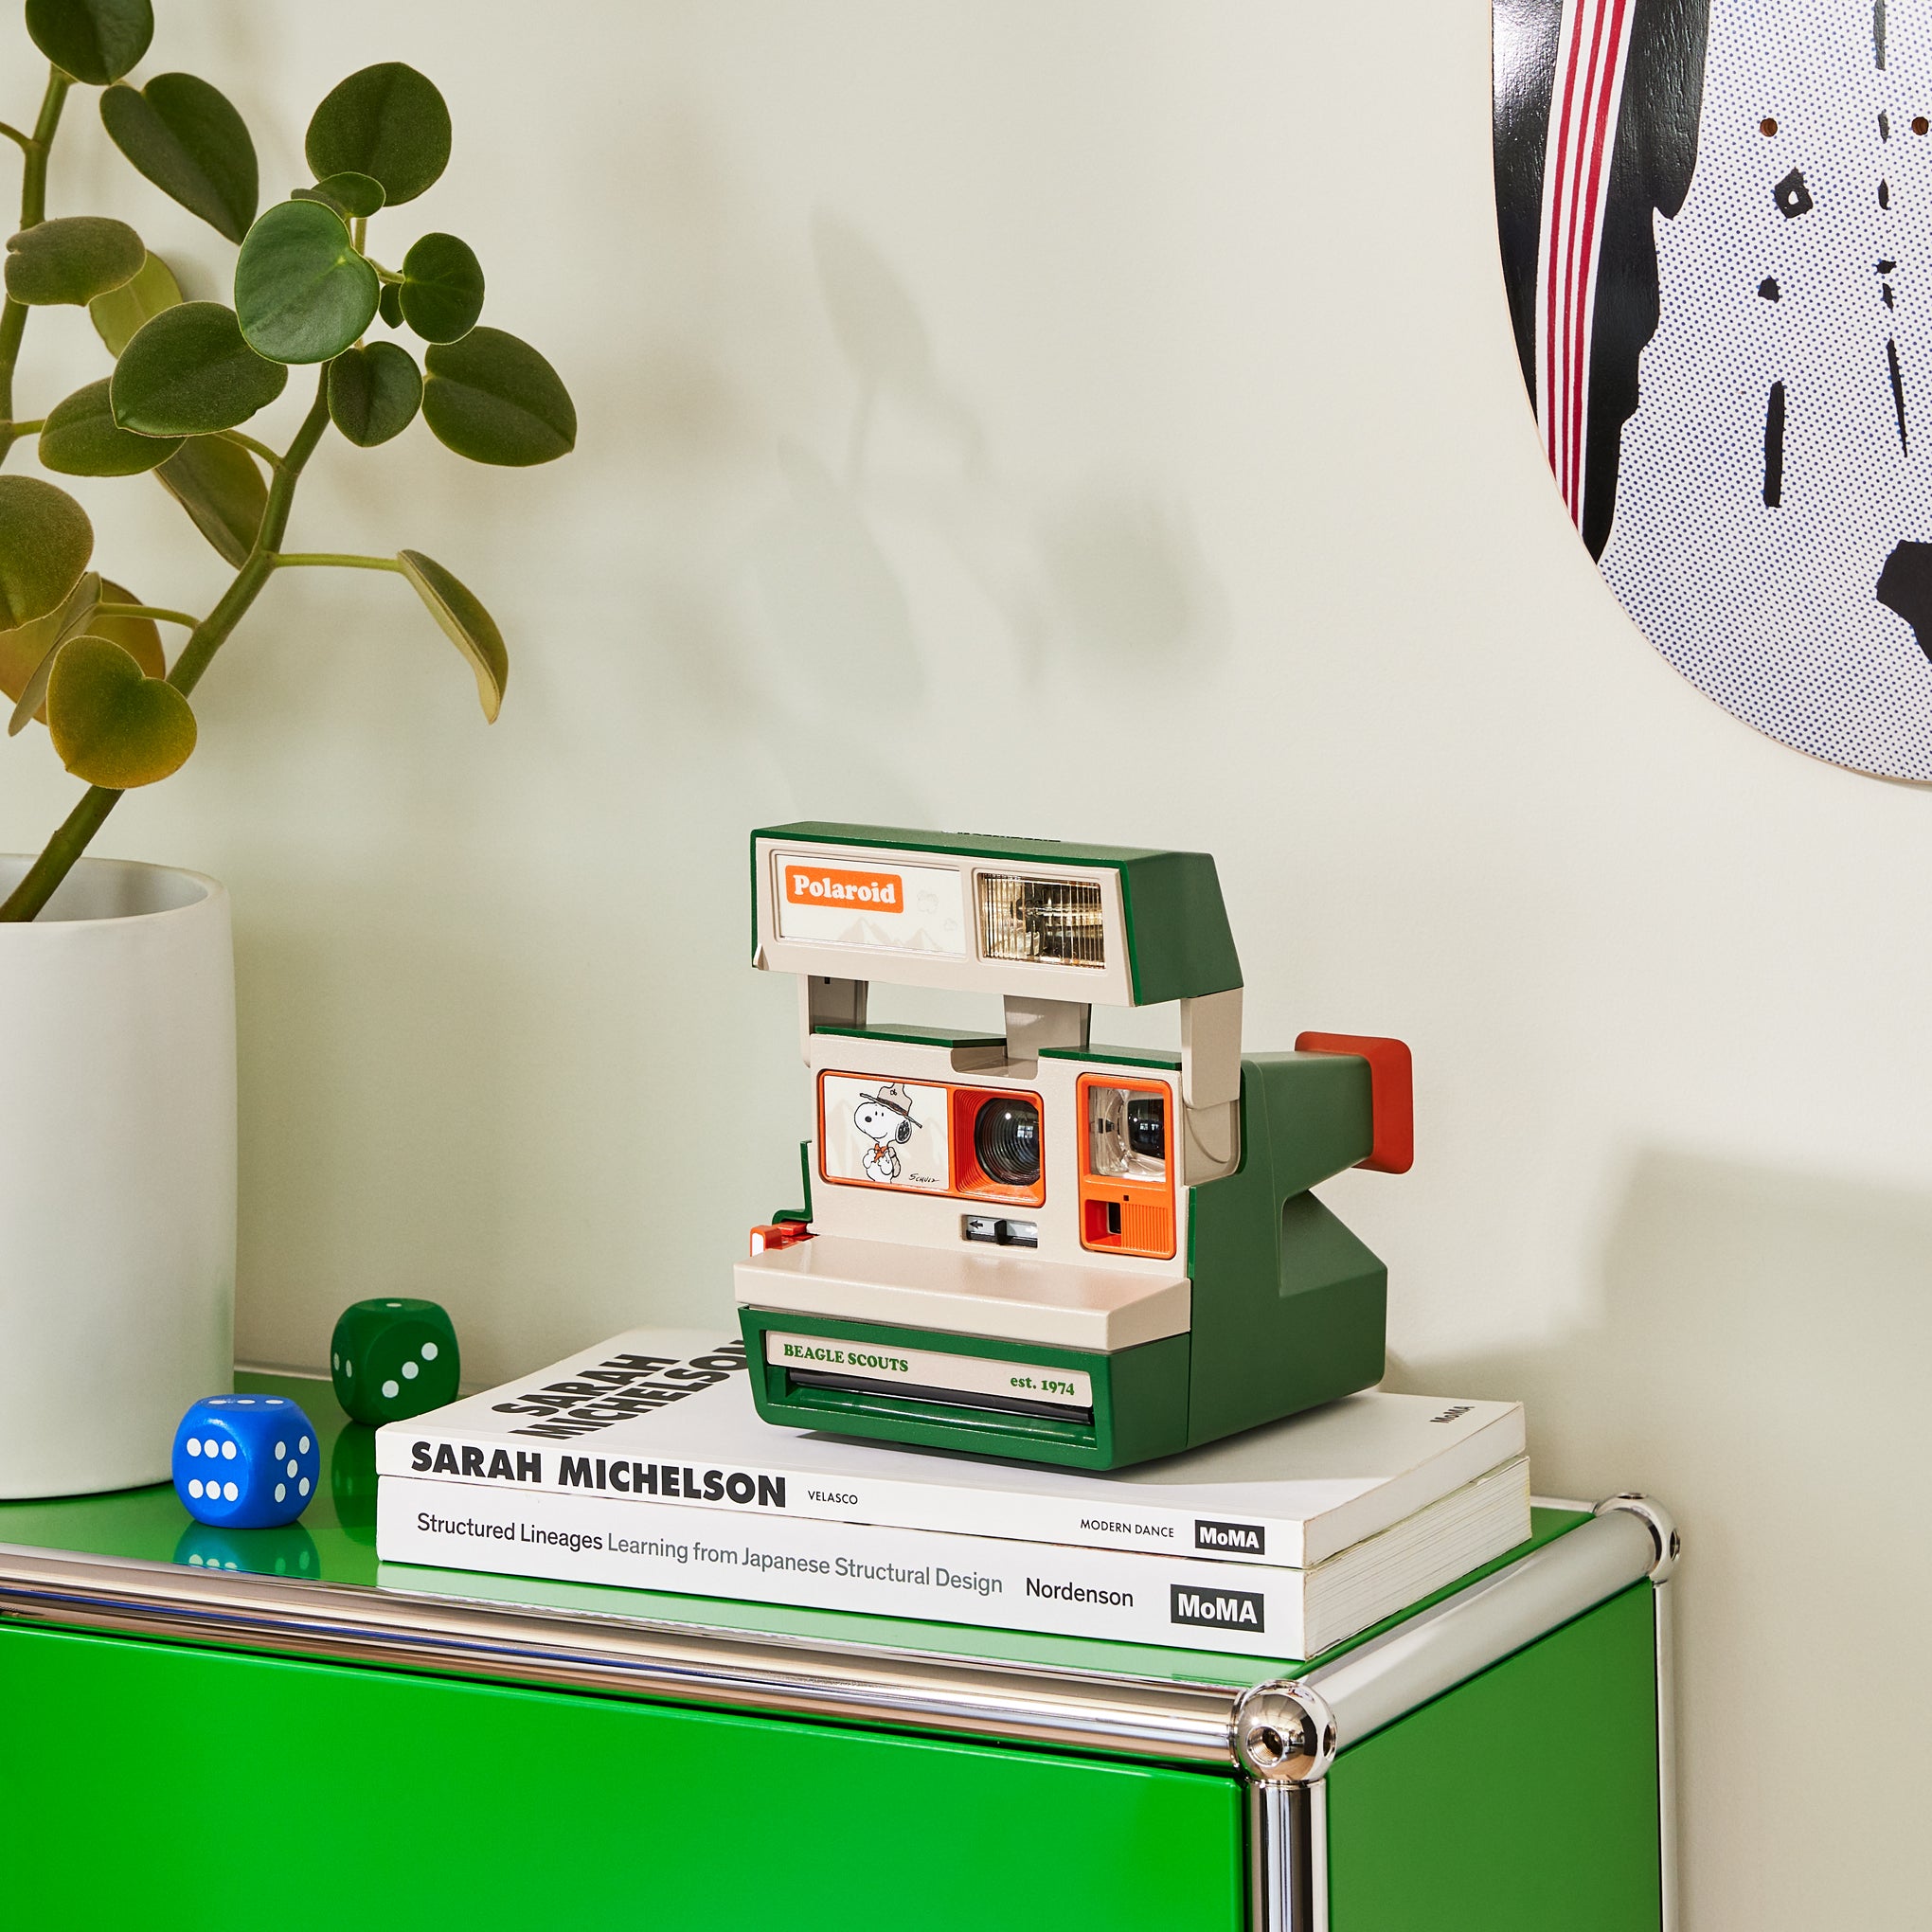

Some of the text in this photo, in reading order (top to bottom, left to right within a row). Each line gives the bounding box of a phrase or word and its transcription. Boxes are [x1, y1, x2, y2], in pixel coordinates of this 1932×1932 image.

[793, 874, 896, 904] Polaroid
[783, 1343, 909, 1372] BEAGLE SCOUTS
[492, 1353, 680, 1417] SARAH
[1010, 1377, 1075, 1396] est. 1974
[1430, 1405, 1476, 1423] MoMA
[410, 1440, 786, 1509] SARAH MICHELSON
[807, 1490, 858, 1505] VELASCO
[1080, 1518, 1174, 1538] MODERN DANCE
[1199, 1526, 1260, 1548] MoMA
[417, 1512, 1003, 1597] Structured Lineages Learning from Japanese Structural Design
[1026, 1577, 1134, 1608] Nordenson
[1177, 1593, 1258, 1624] MoMA
